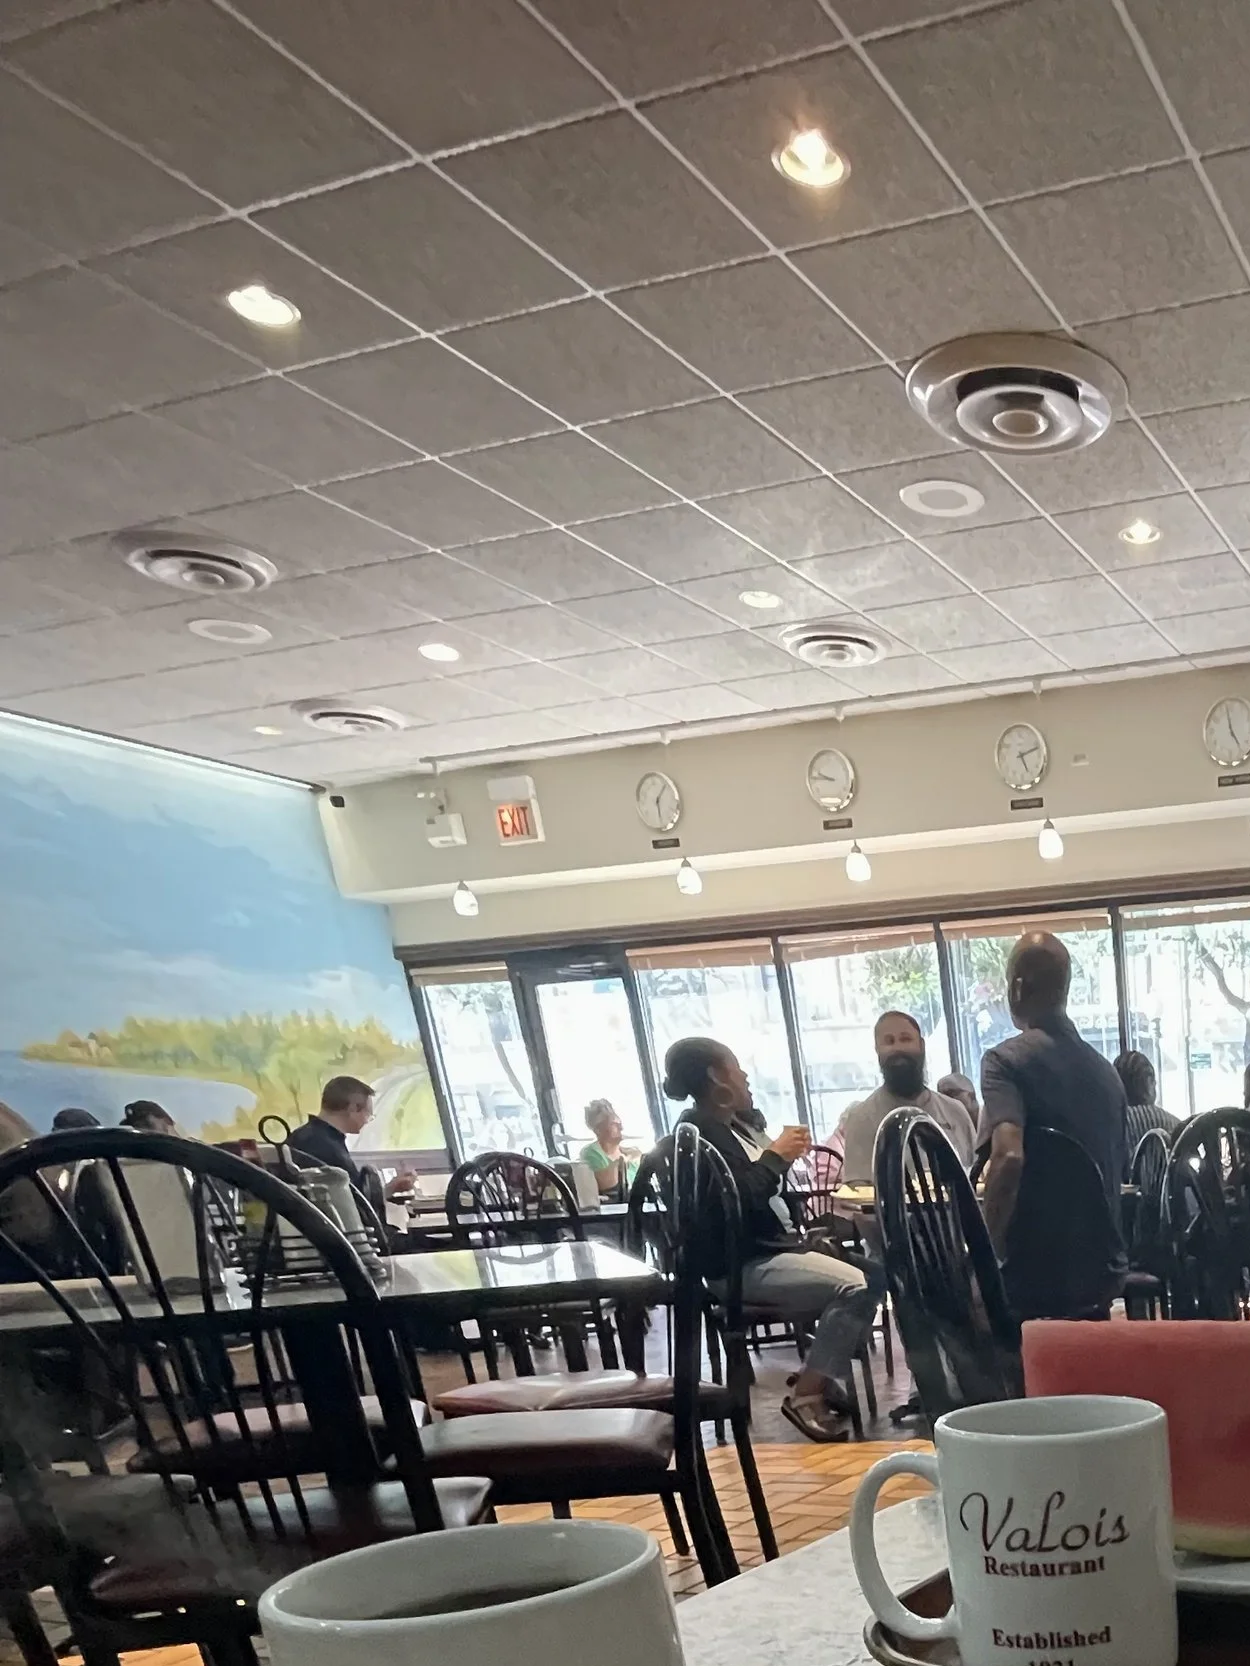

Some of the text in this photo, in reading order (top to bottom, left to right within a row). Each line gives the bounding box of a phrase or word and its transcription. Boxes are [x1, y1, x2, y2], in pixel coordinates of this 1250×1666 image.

[498, 806, 530, 838] EXIT
[984, 1556, 1106, 1577] Restaurant
[992, 1626, 1112, 1649] Established
